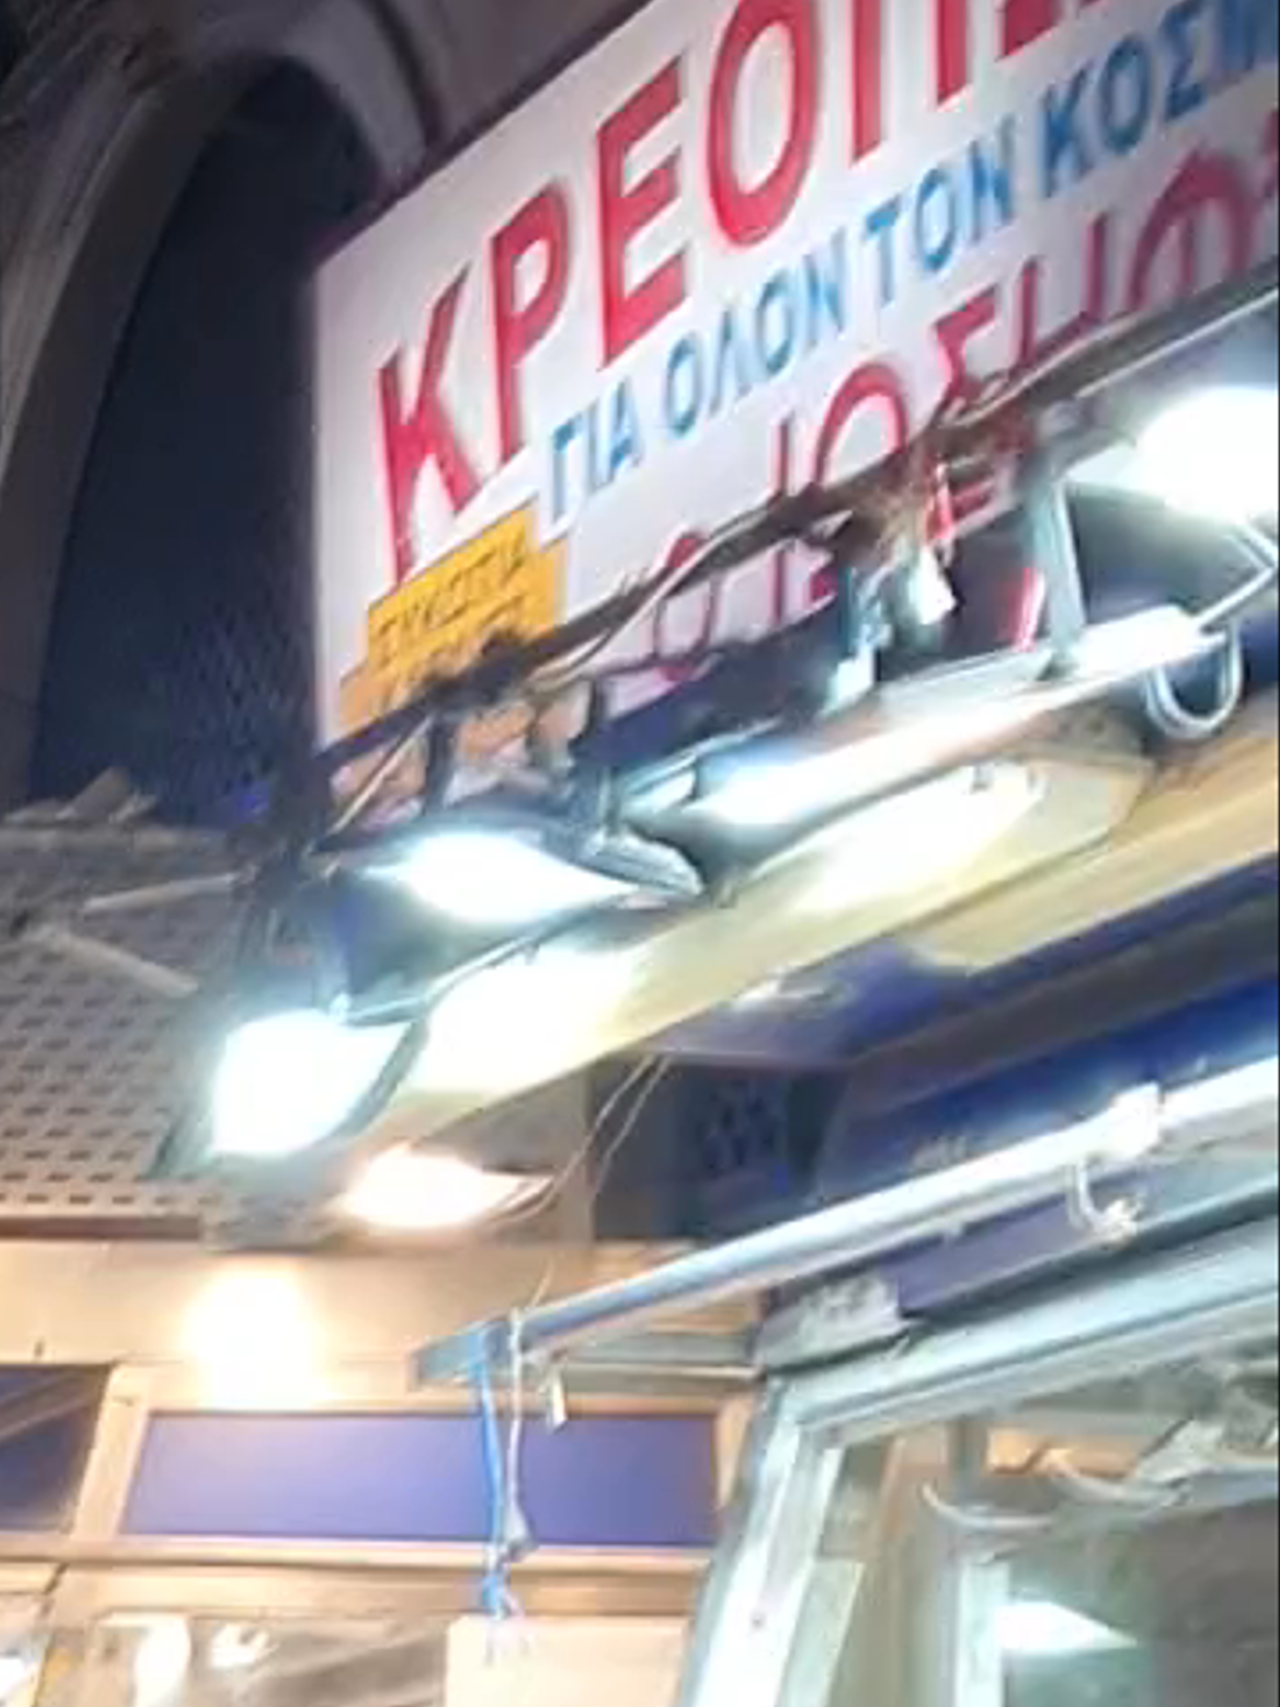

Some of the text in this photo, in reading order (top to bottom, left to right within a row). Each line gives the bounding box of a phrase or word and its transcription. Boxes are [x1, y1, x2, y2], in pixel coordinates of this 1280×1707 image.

[548, 378, 642, 525] ΓΙΑ
[665, 229, 847, 439] ΟΛΟΝ
[864, 115, 1017, 305] ΤΟΝ
